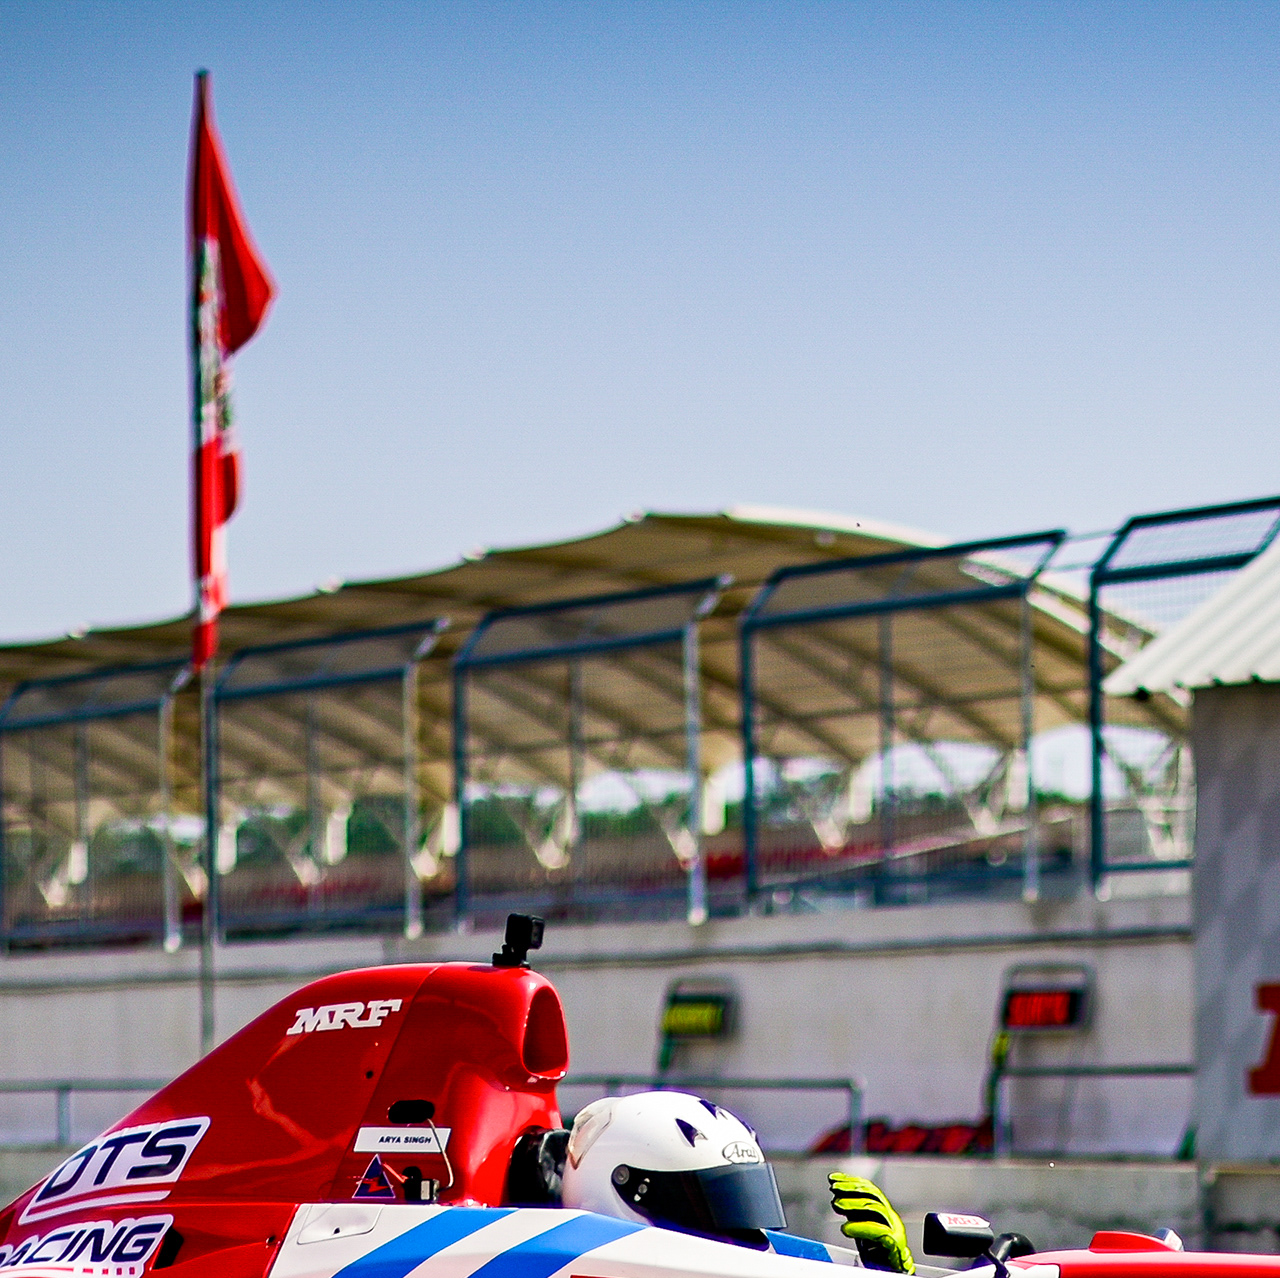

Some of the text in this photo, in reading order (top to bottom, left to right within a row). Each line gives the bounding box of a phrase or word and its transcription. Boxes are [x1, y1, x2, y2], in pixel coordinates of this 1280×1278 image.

[286, 999, 403, 1035] MRF
[378, 1135, 432, 1145] ARYA SINGH
